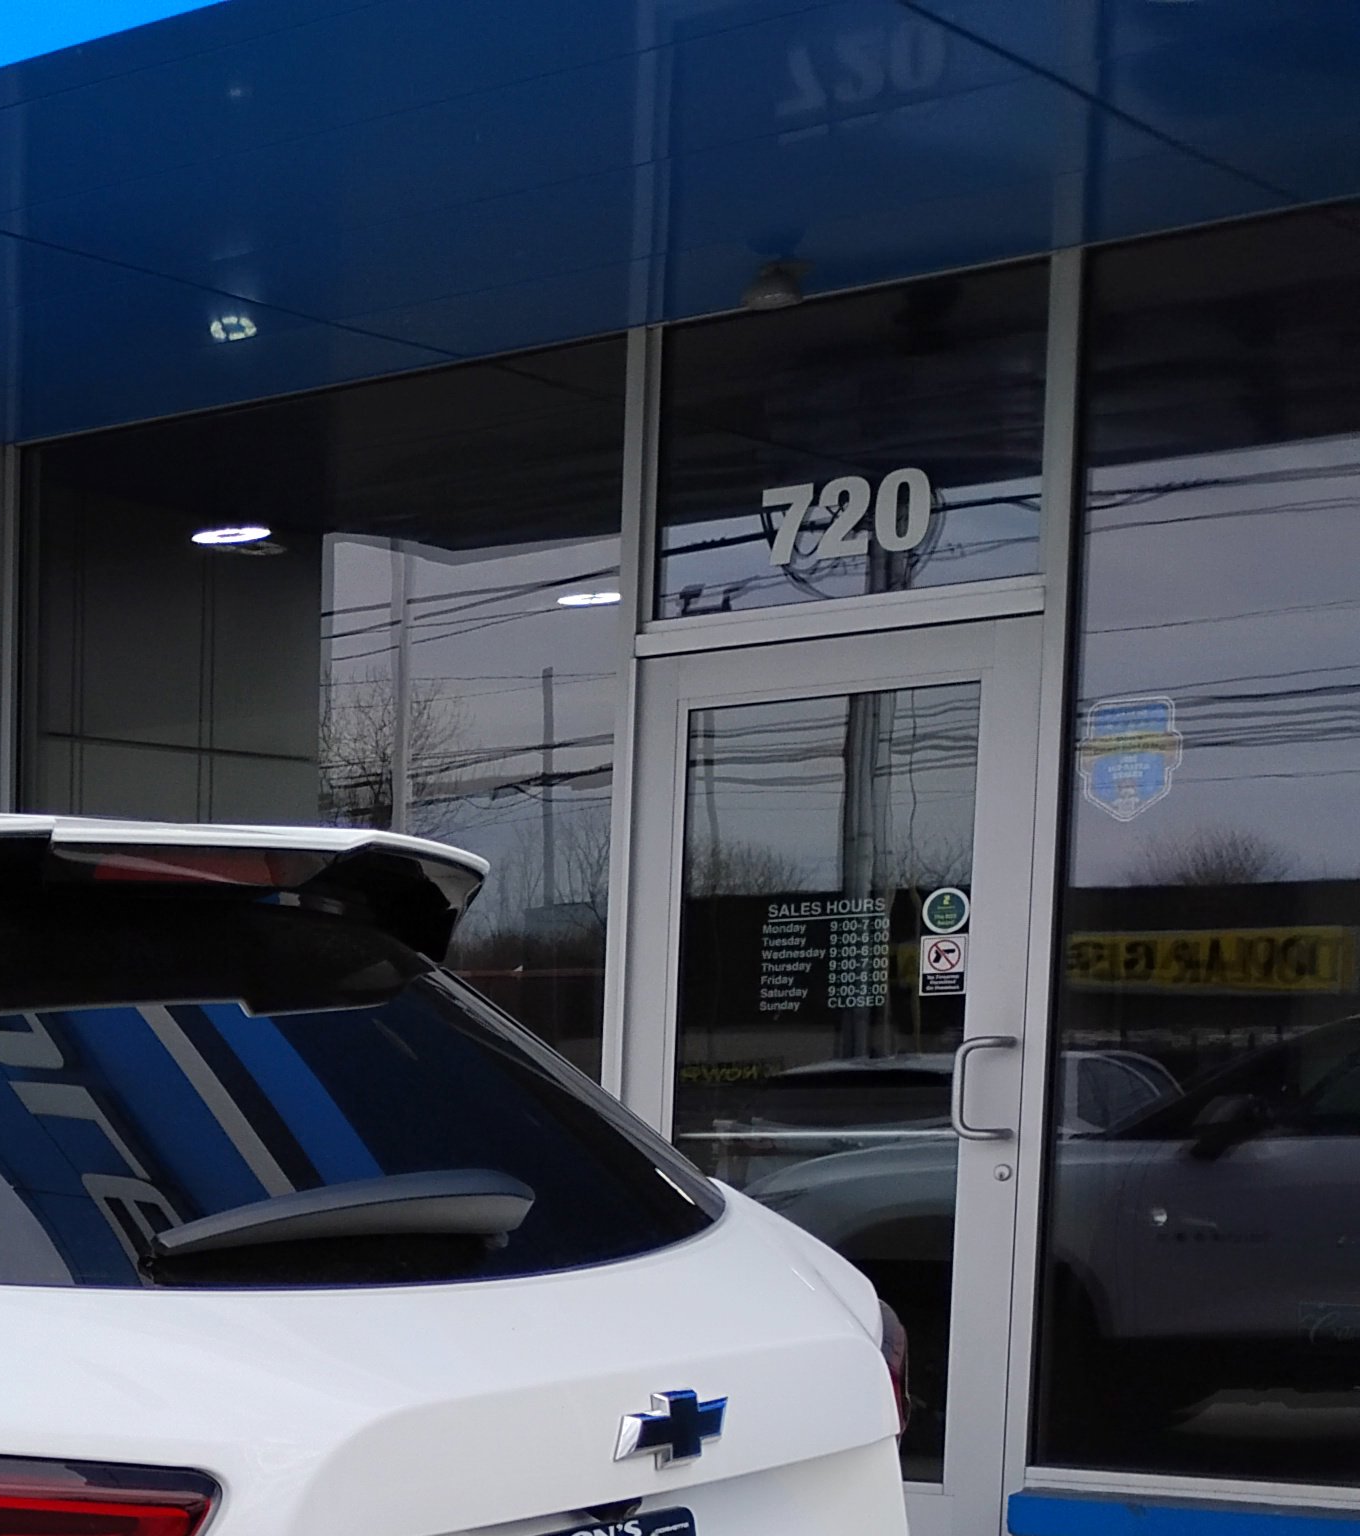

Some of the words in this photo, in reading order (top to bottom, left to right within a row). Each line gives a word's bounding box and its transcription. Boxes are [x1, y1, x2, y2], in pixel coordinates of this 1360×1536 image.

[762, 467, 931, 567] 720
[768, 901, 821, 918] SALES
[826, 897, 886, 914] HOURS
[762, 924, 807, 934] Monday
[762, 936, 807, 947] Tuesday
[761, 948, 826, 959] Wednesday
[761, 961, 812, 973] Thursday
[760, 975, 794, 986] Friday
[760, 988, 808, 999] Saturday
[759, 1001, 800, 1012] Sunday
[827, 995, 885, 1008] CLOSED
